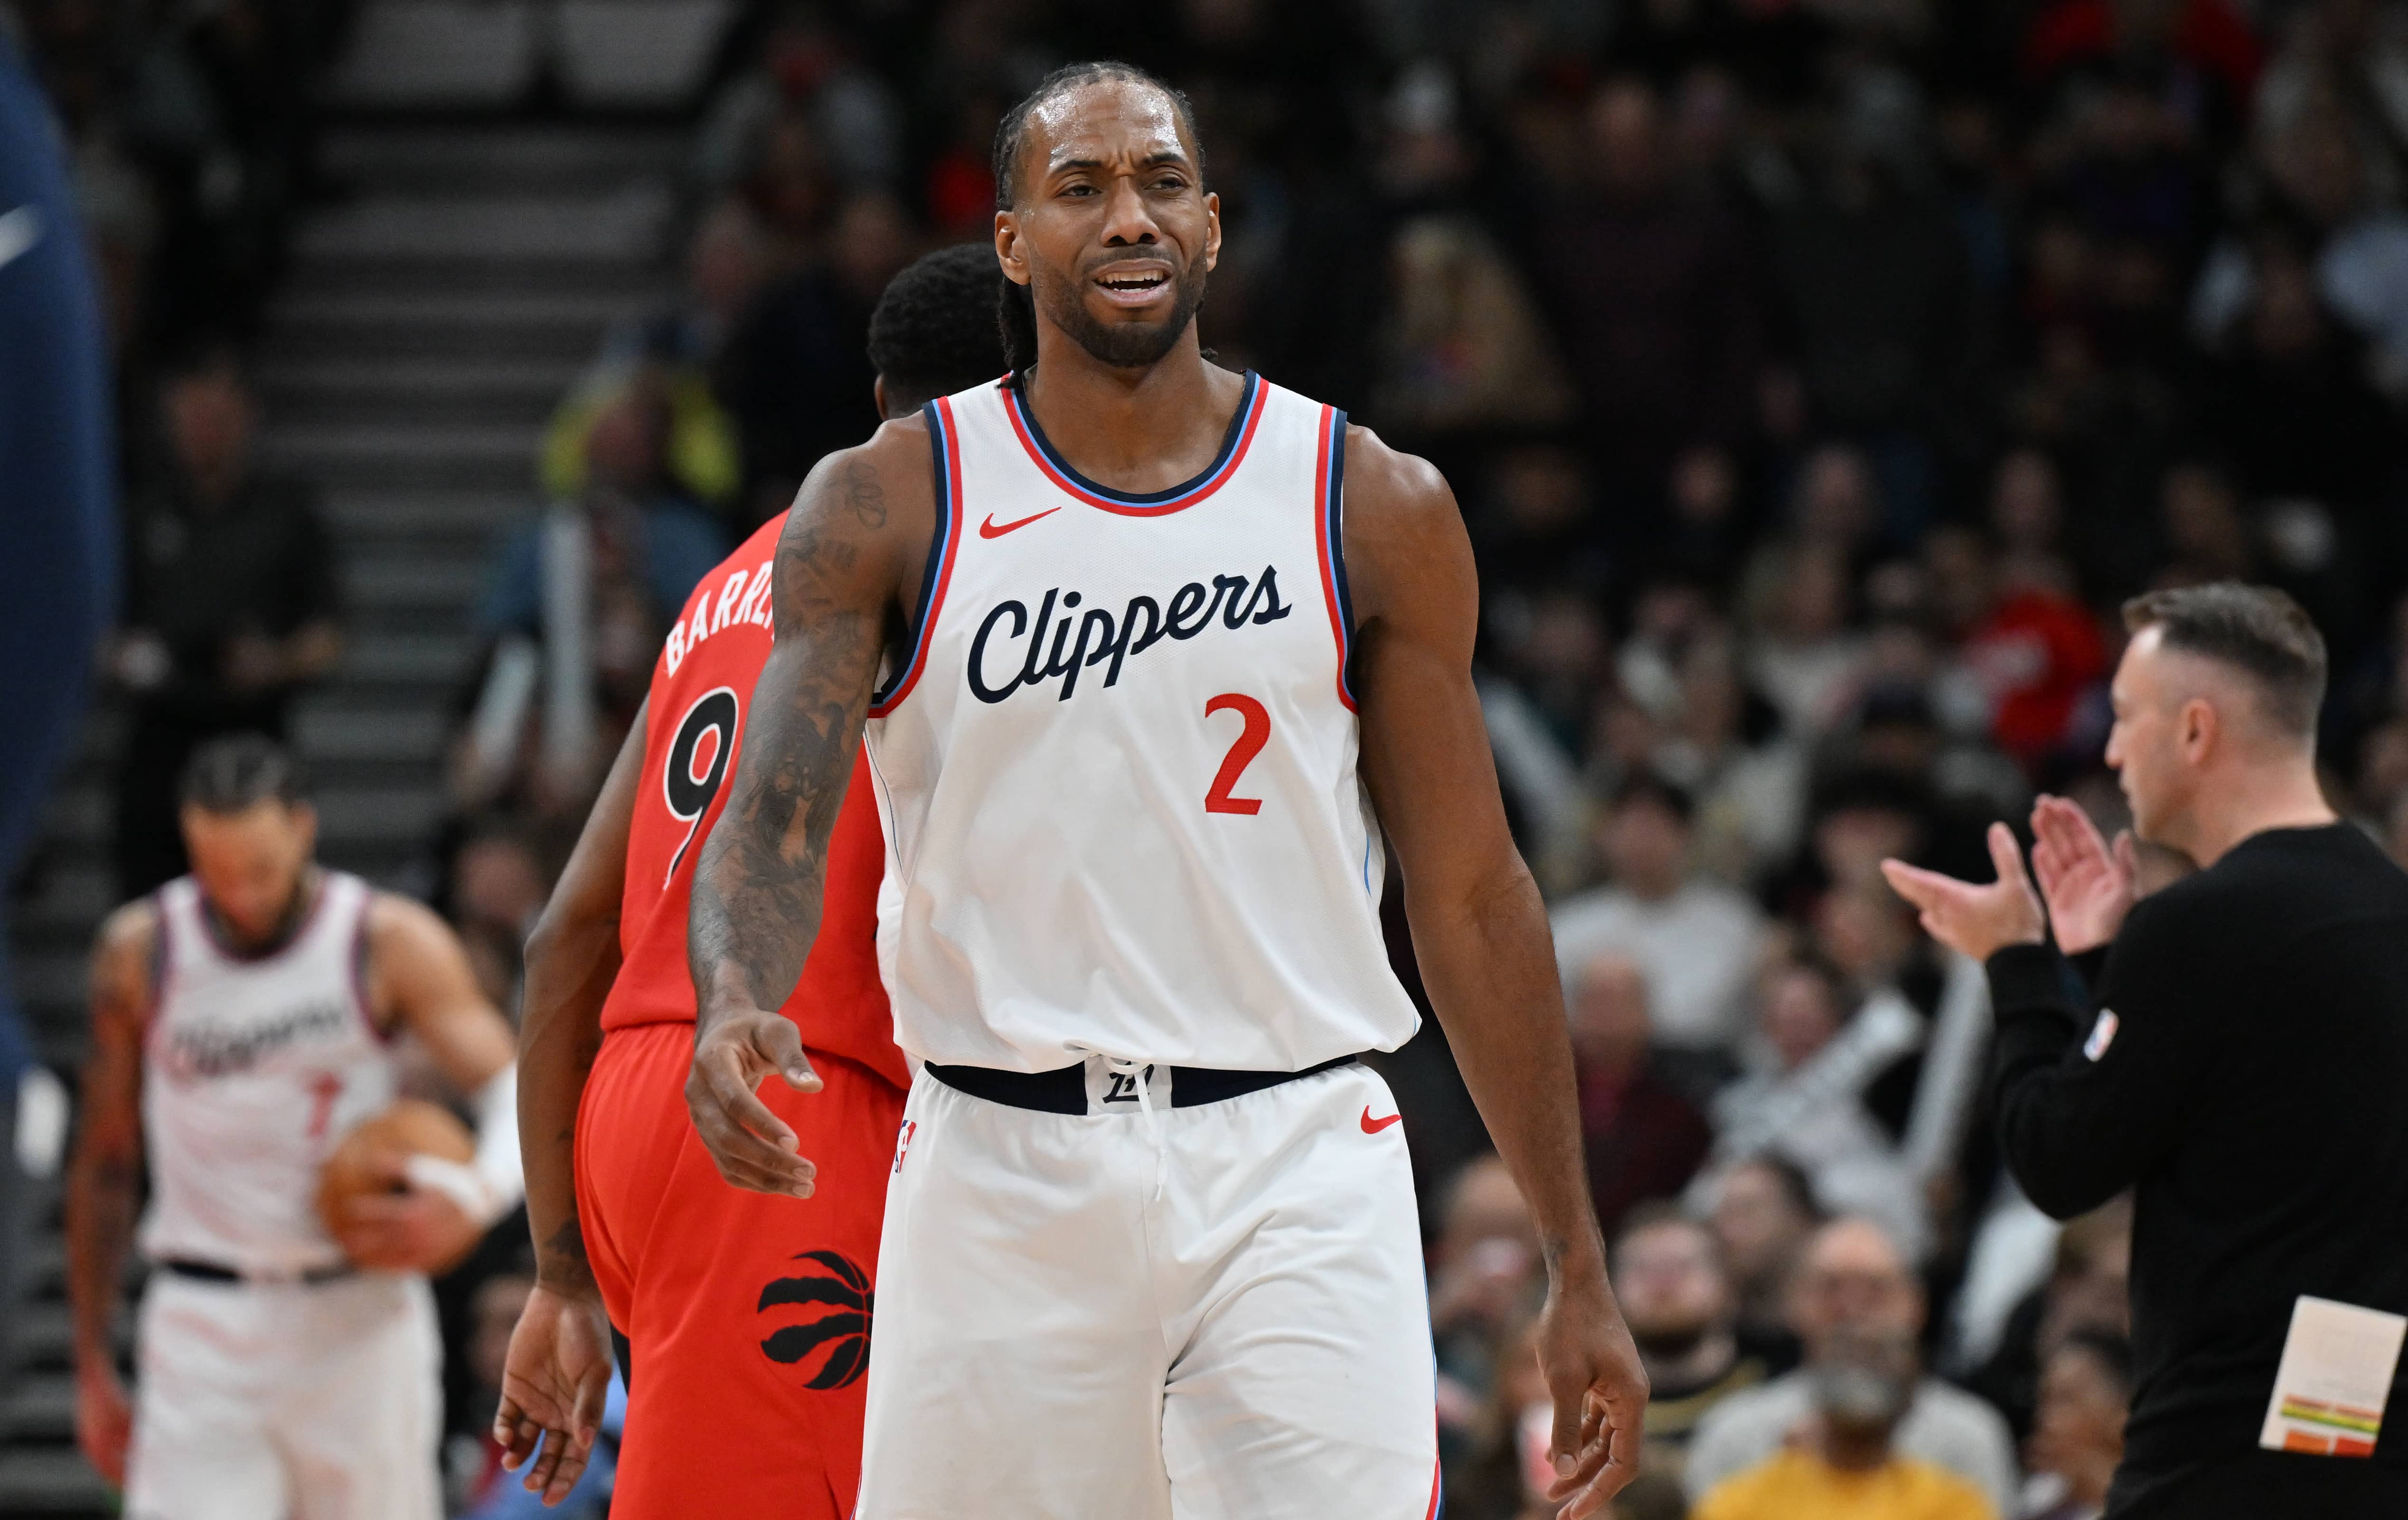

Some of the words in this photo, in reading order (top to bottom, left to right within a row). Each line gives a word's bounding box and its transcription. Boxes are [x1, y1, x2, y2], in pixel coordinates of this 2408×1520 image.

[666, 560, 774, 679] BARRE
[967, 564, 1293, 704] Clippers
[664, 686, 739, 891] 9
[1204, 693, 1271, 816] 2
